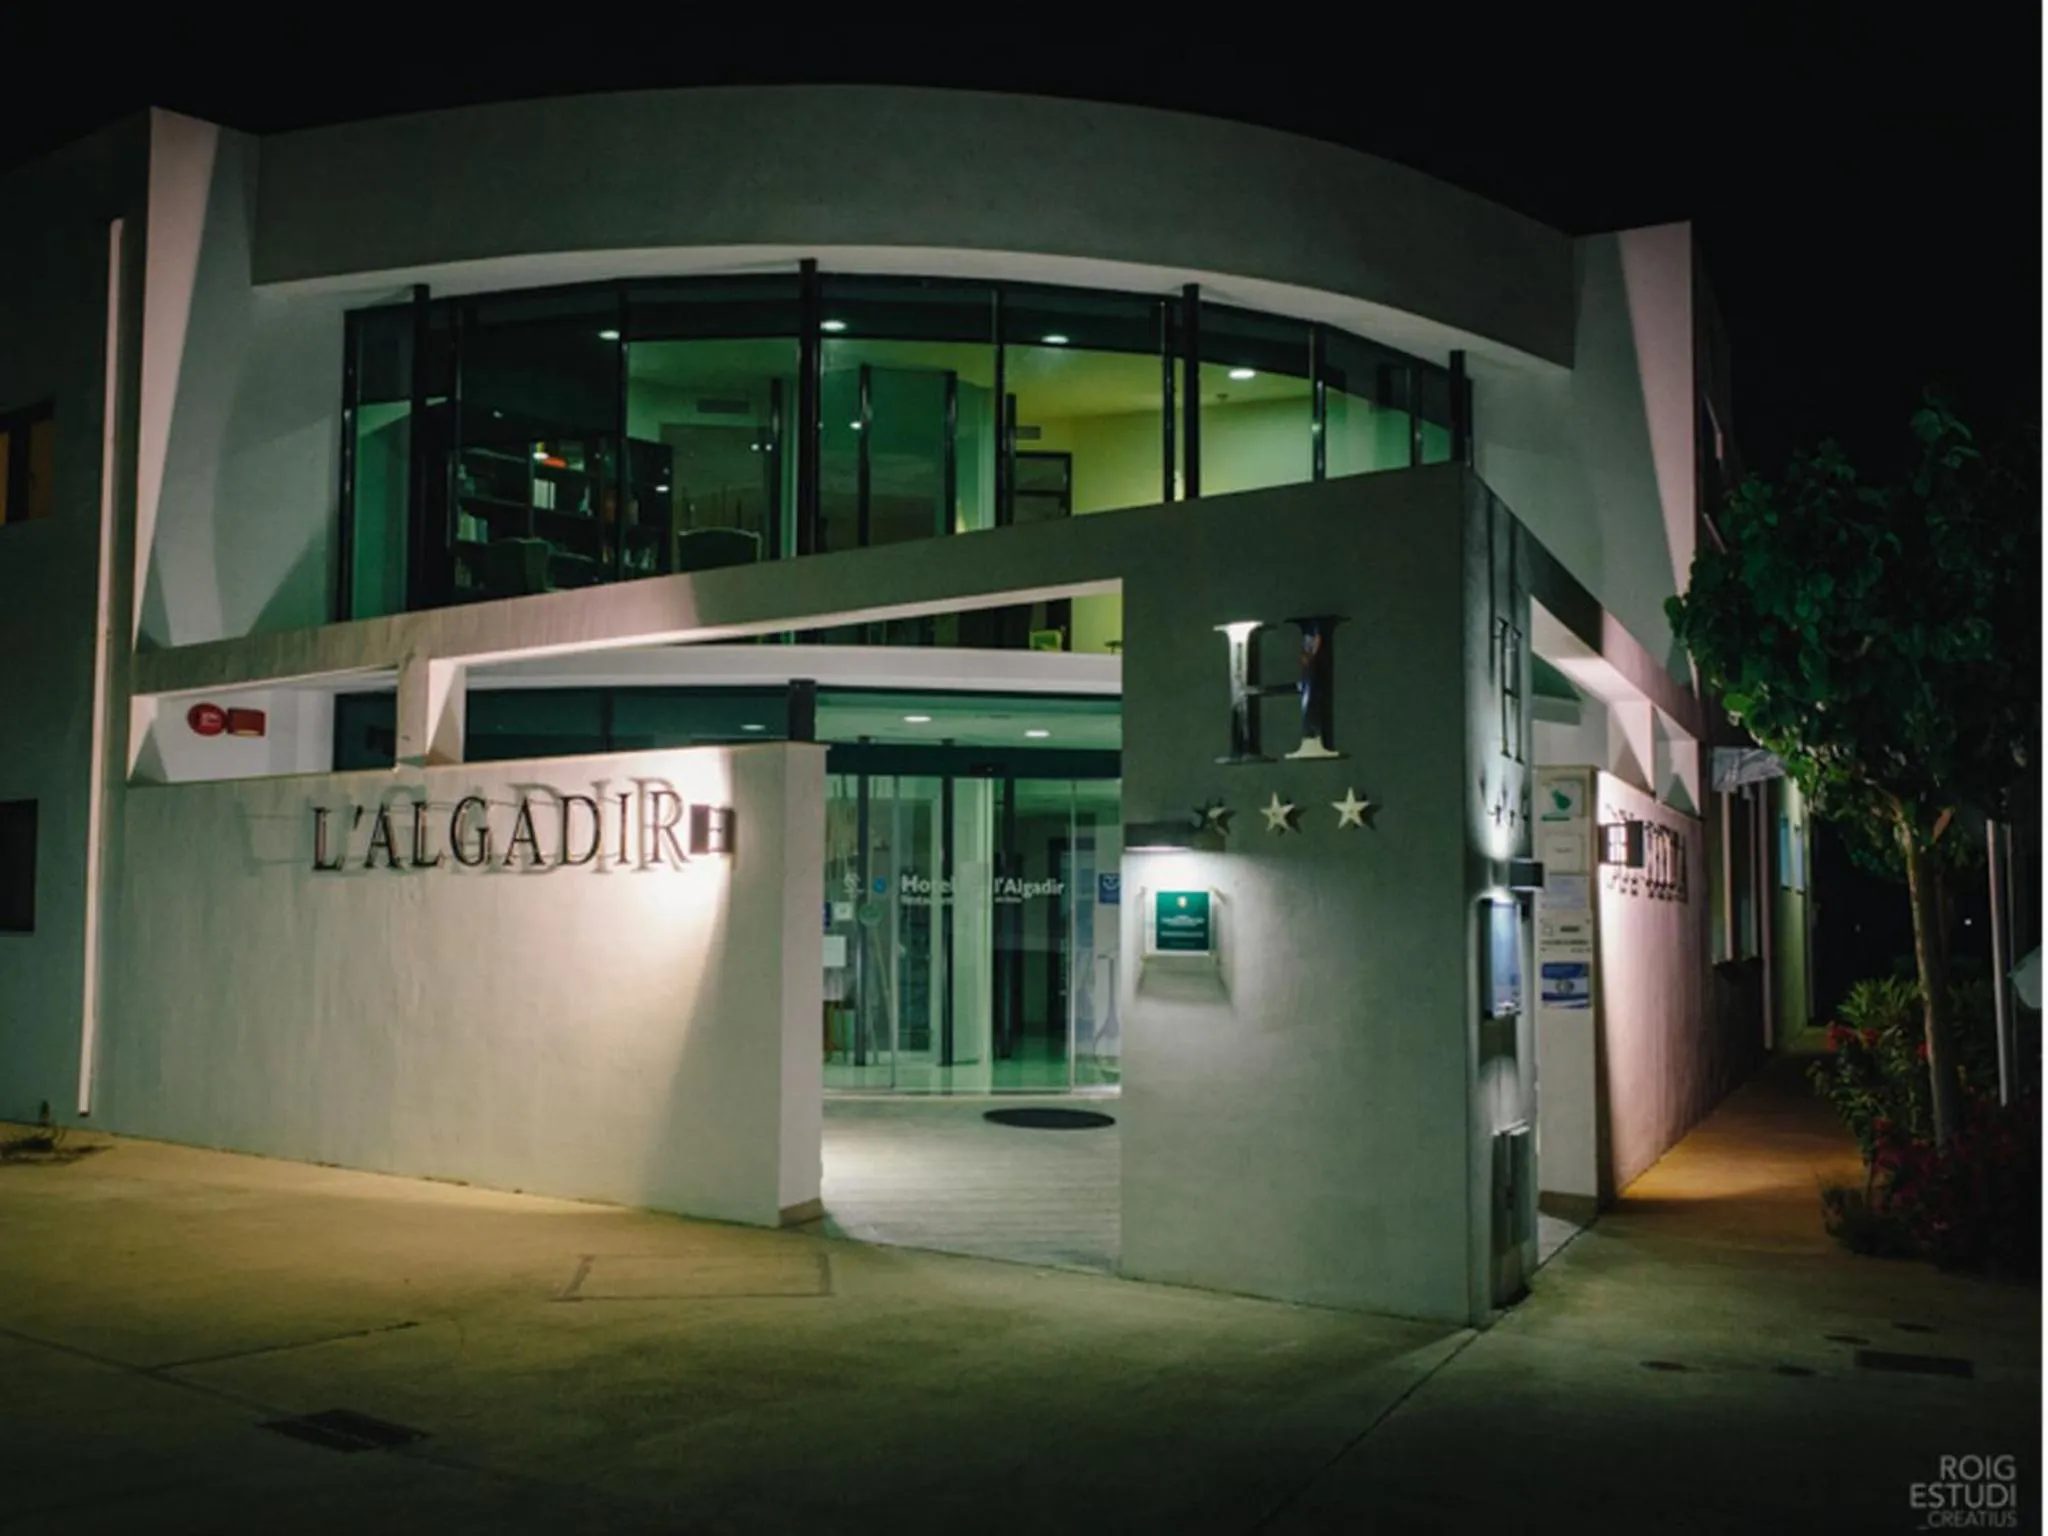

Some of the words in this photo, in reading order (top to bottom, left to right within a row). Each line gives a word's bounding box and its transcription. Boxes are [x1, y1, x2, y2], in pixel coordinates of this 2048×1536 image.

[1213, 615, 1351, 765] H
[312, 789, 687, 871] L'ALGADIR
[901, 874, 957, 894] Hoel
[994, 877, 1065, 899] l'Algadir
